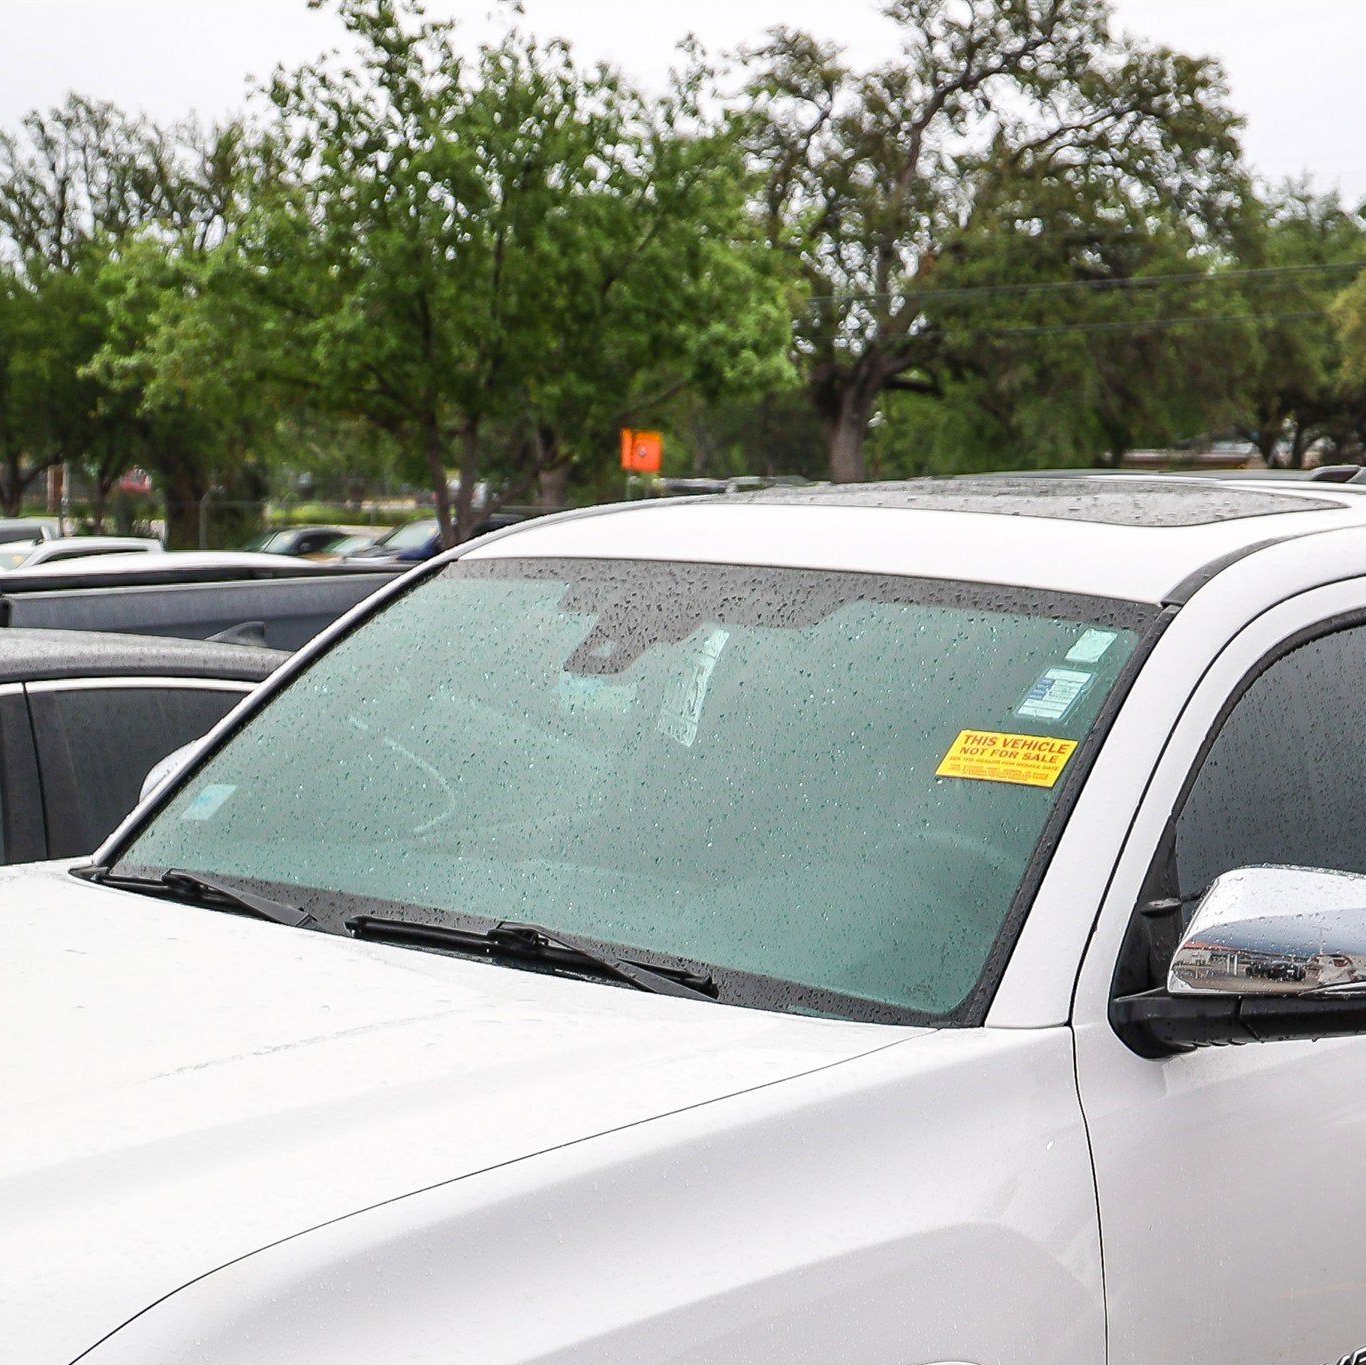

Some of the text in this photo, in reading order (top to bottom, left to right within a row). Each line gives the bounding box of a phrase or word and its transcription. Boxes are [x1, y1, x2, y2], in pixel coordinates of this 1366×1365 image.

[963, 734, 1070, 755] THIS VEHICLE
[959, 747, 1060, 763] NOT FOR SALE
